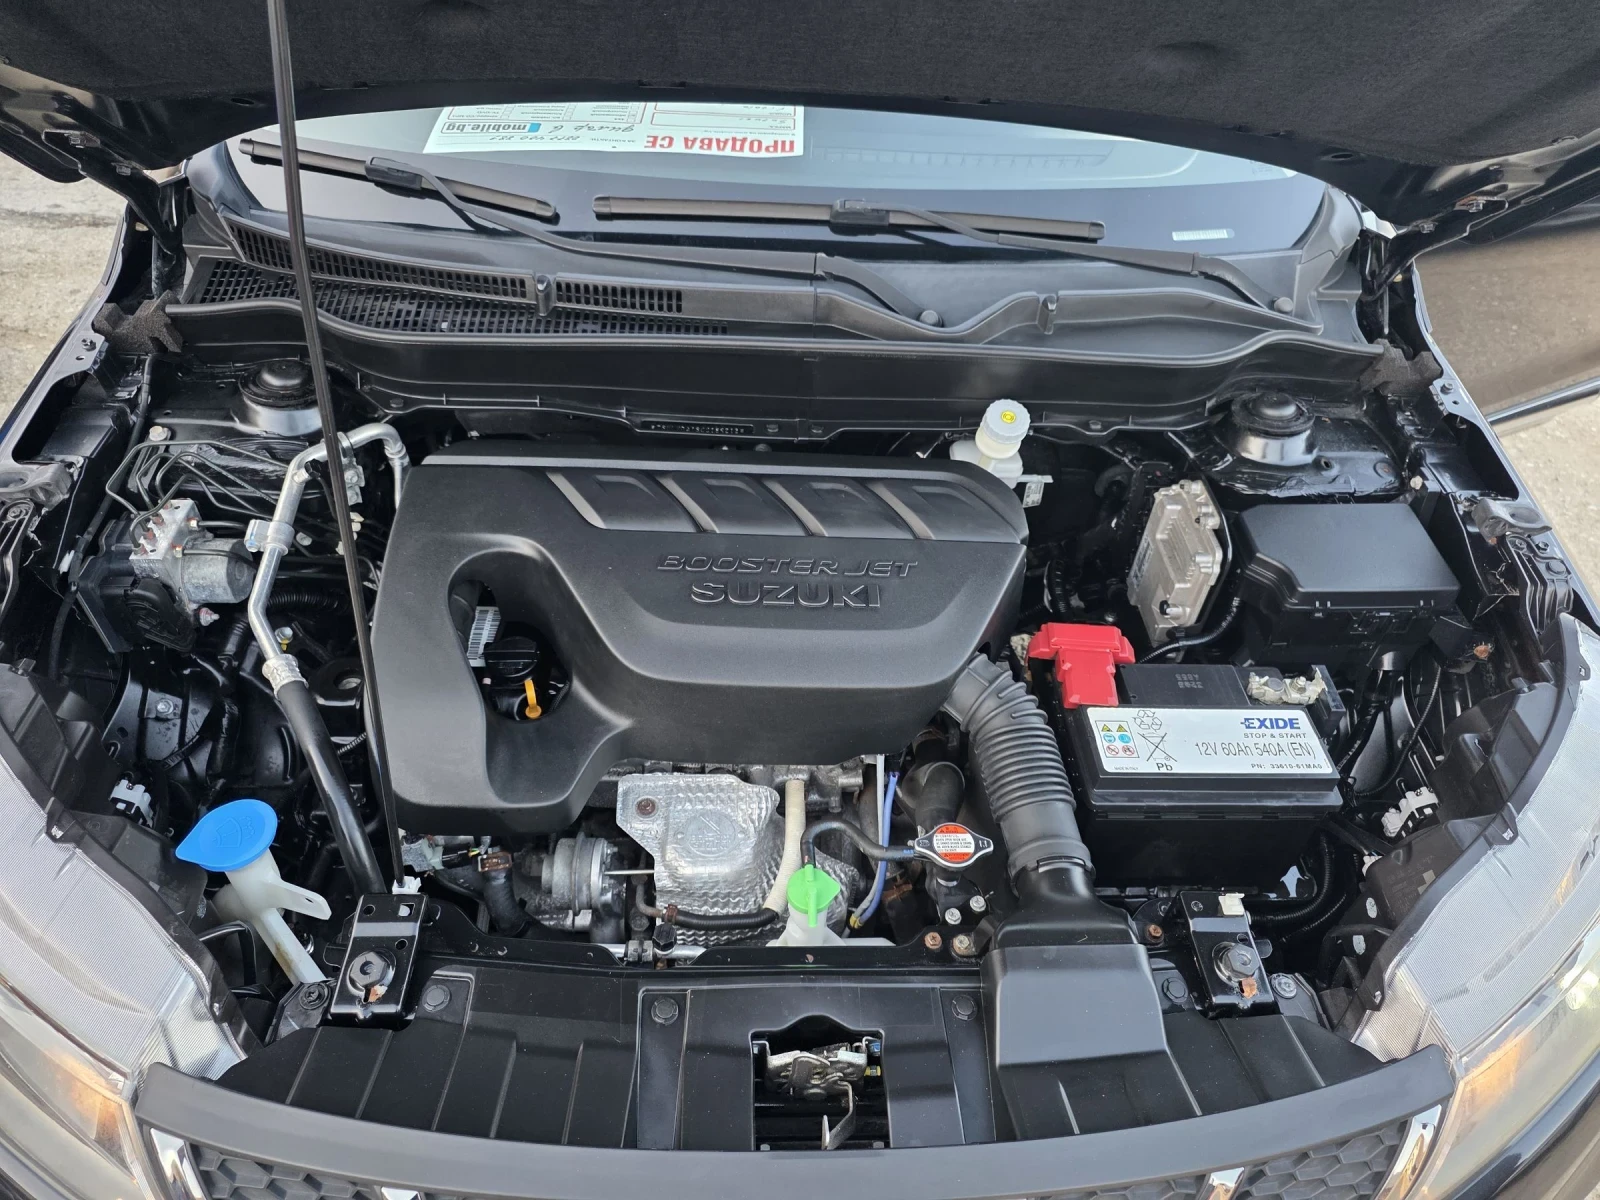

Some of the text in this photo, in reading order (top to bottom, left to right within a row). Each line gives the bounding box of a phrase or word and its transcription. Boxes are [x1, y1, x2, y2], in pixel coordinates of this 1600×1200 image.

[445, 122, 528, 133] mobile.bg
[644, 135, 795, 154] ПРОДАВА СЕ
[690, 581, 881, 608] SUZUKI
[1241, 717, 1301, 730] EXIDE
[1195, 741, 1316, 760] 12V 60Ah 540A (EN)
[1155, 762, 1173, 771] Pb
